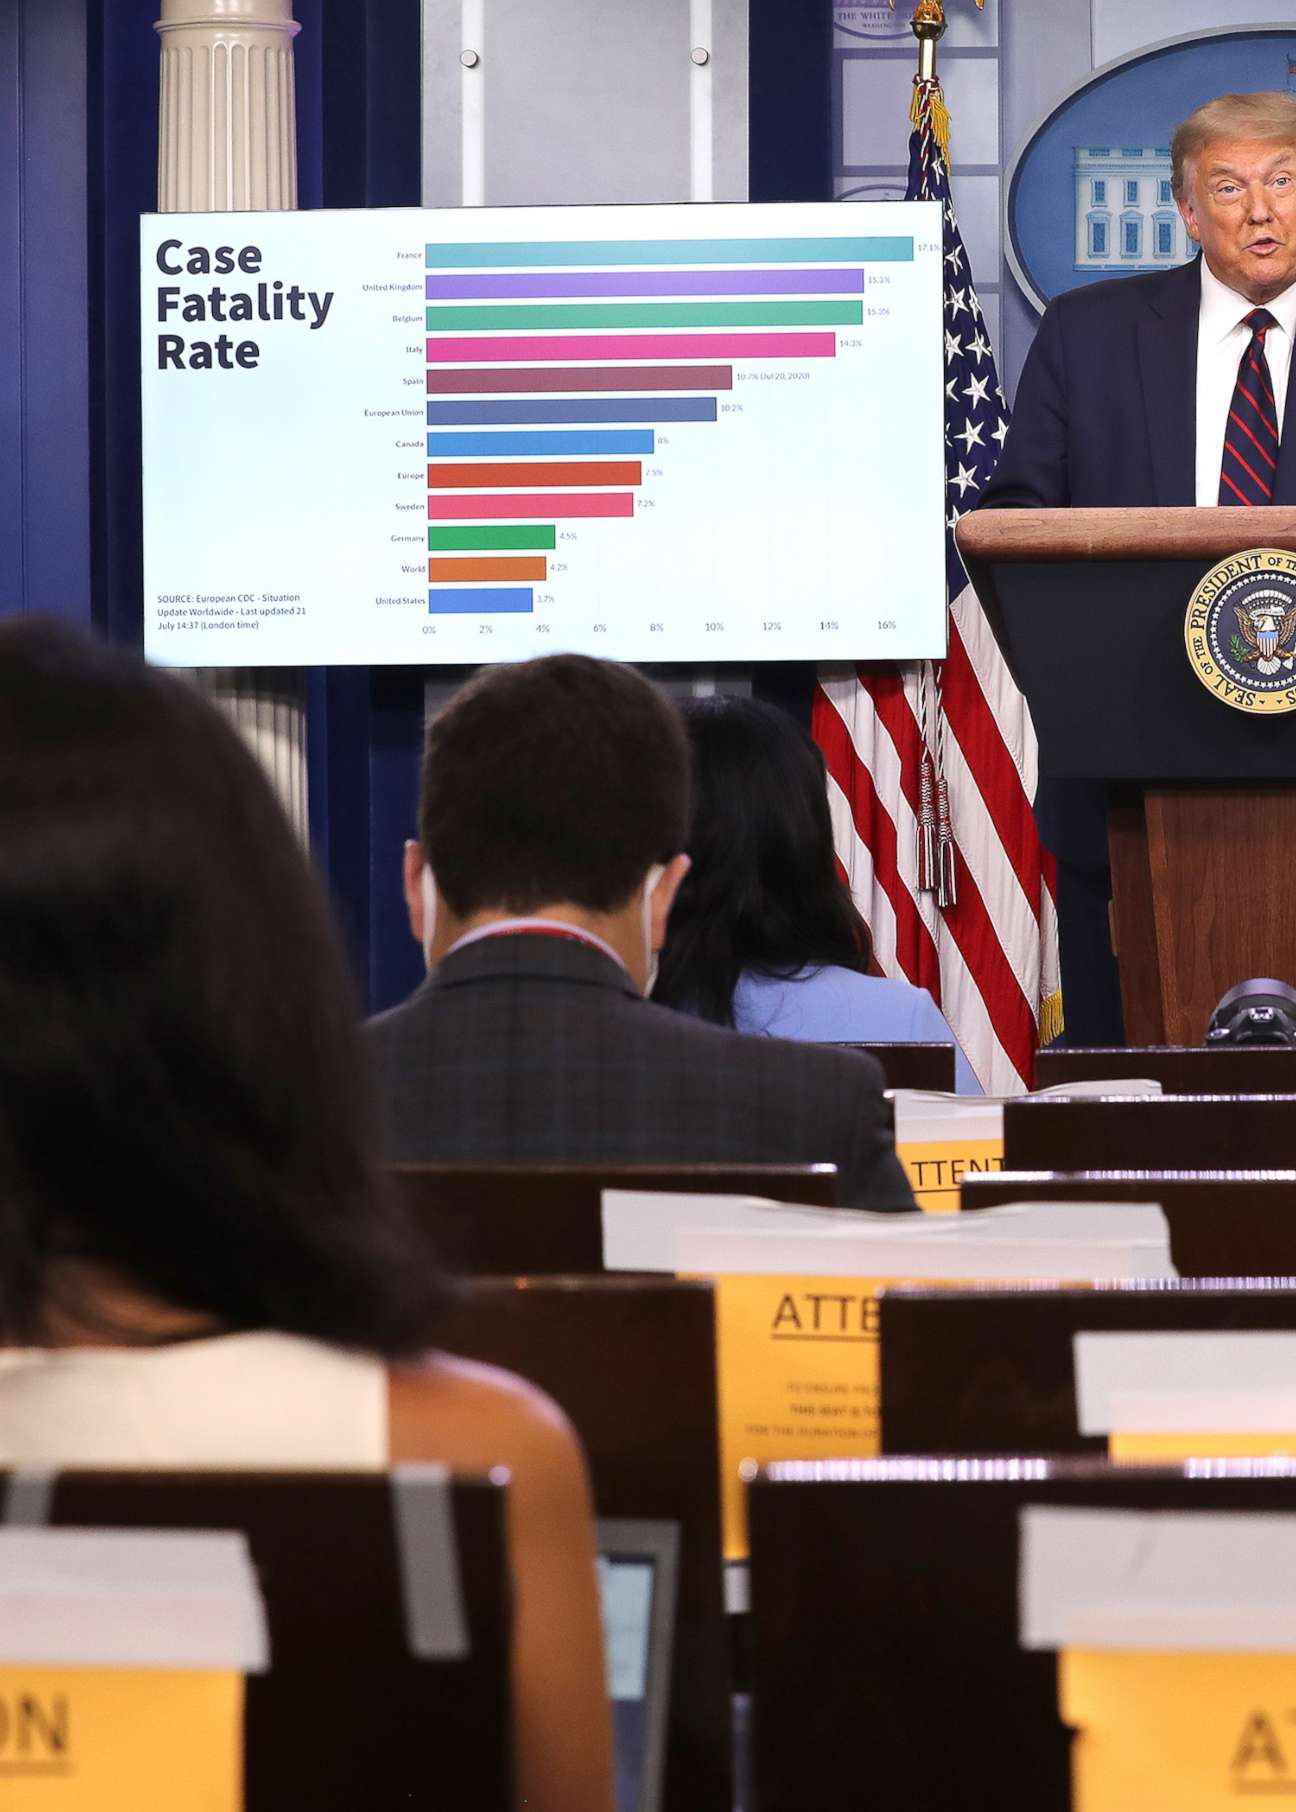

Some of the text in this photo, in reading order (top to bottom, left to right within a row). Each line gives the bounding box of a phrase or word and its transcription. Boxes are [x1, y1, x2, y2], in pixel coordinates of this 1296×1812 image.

[917, 244, 941, 252] 17.1%
[156, 239, 262, 275] Case
[397, 251, 422, 259] France
[362, 283, 423, 292] United Kingdom
[157, 280, 334, 329] Fatality
[392, 314, 423, 323] Belgium
[158, 334, 260, 369] Rate
[406, 345, 423, 354] Italy
[403, 377, 424, 386] Spain
[364, 409, 424, 417] European Union
[395, 440, 424, 448] Canada
[397, 472, 425, 481] Europe
[395, 503, 425, 511] Sweden
[391, 534, 425, 544] Germany
[1268, 557, 1283, 567] OF
[401, 565, 426, 573] World
[1190, 555, 1262, 631] PRESIDENT
[157, 594, 194, 603] SOURCE:
[196, 594, 236, 605] European
[237, 594, 257, 603] CDC
[262, 593, 300, 603] Situation
[375, 597, 426, 605] United States
[157, 608, 187, 618] Update
[189, 608, 234, 616] Worldwide
[240, 607, 257, 616] Last
[259, 607, 294, 618] updated
[296, 607, 306, 616] 21
[157, 620, 259, 632] July 14:37 (London time)
[422, 621, 897, 635] 0% 2% 4% 6% 8% 10% 12% 14% 16%
[1192, 635, 1206, 659] THE
[1200, 660, 1214, 675] OF
[1214, 673, 1257, 706] SEAL
